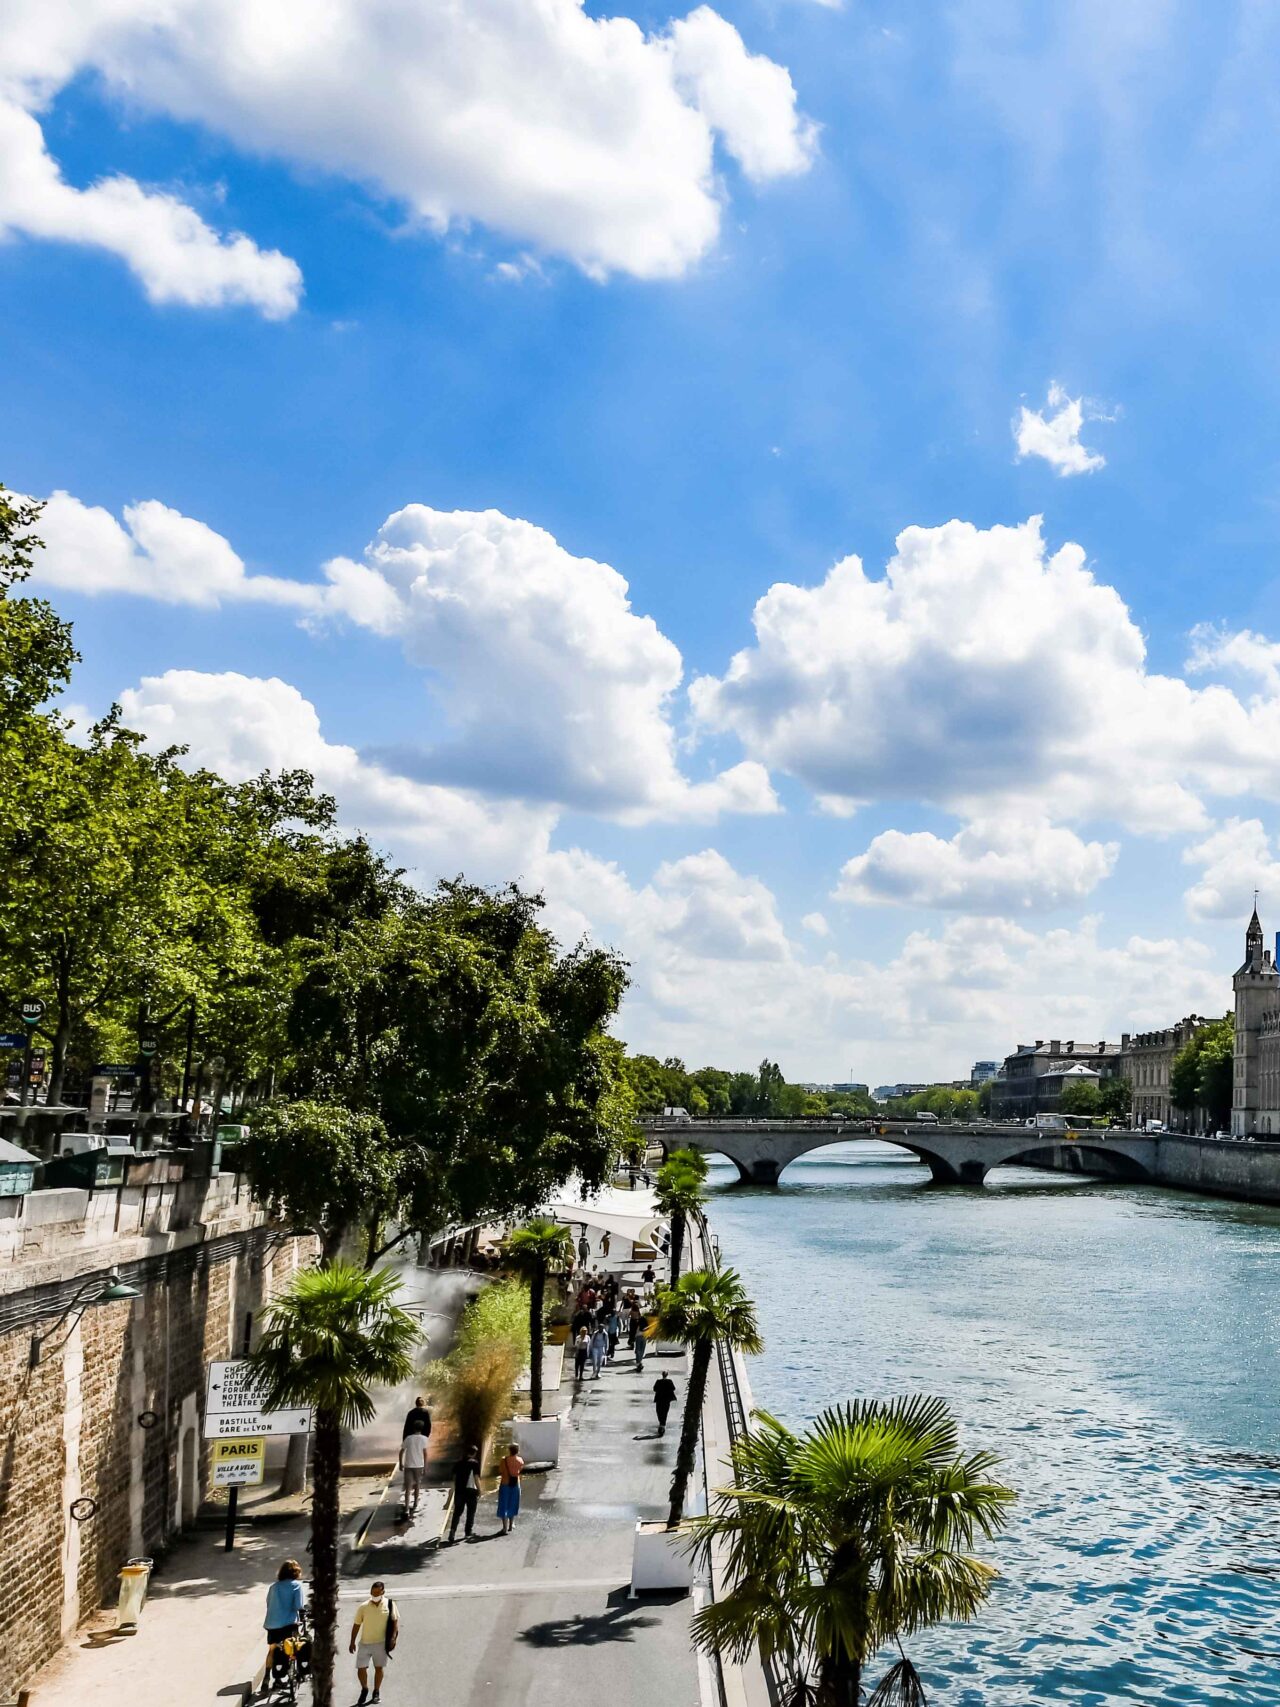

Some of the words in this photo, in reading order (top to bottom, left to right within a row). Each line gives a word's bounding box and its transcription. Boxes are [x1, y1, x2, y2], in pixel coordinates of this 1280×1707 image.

[23, 1003, 41, 1012] BUS
[142, 1040, 157, 1048] BUS
[219, 1417, 257, 1425] BASTILLE
[221, 1443, 258, 1456] PARIS
